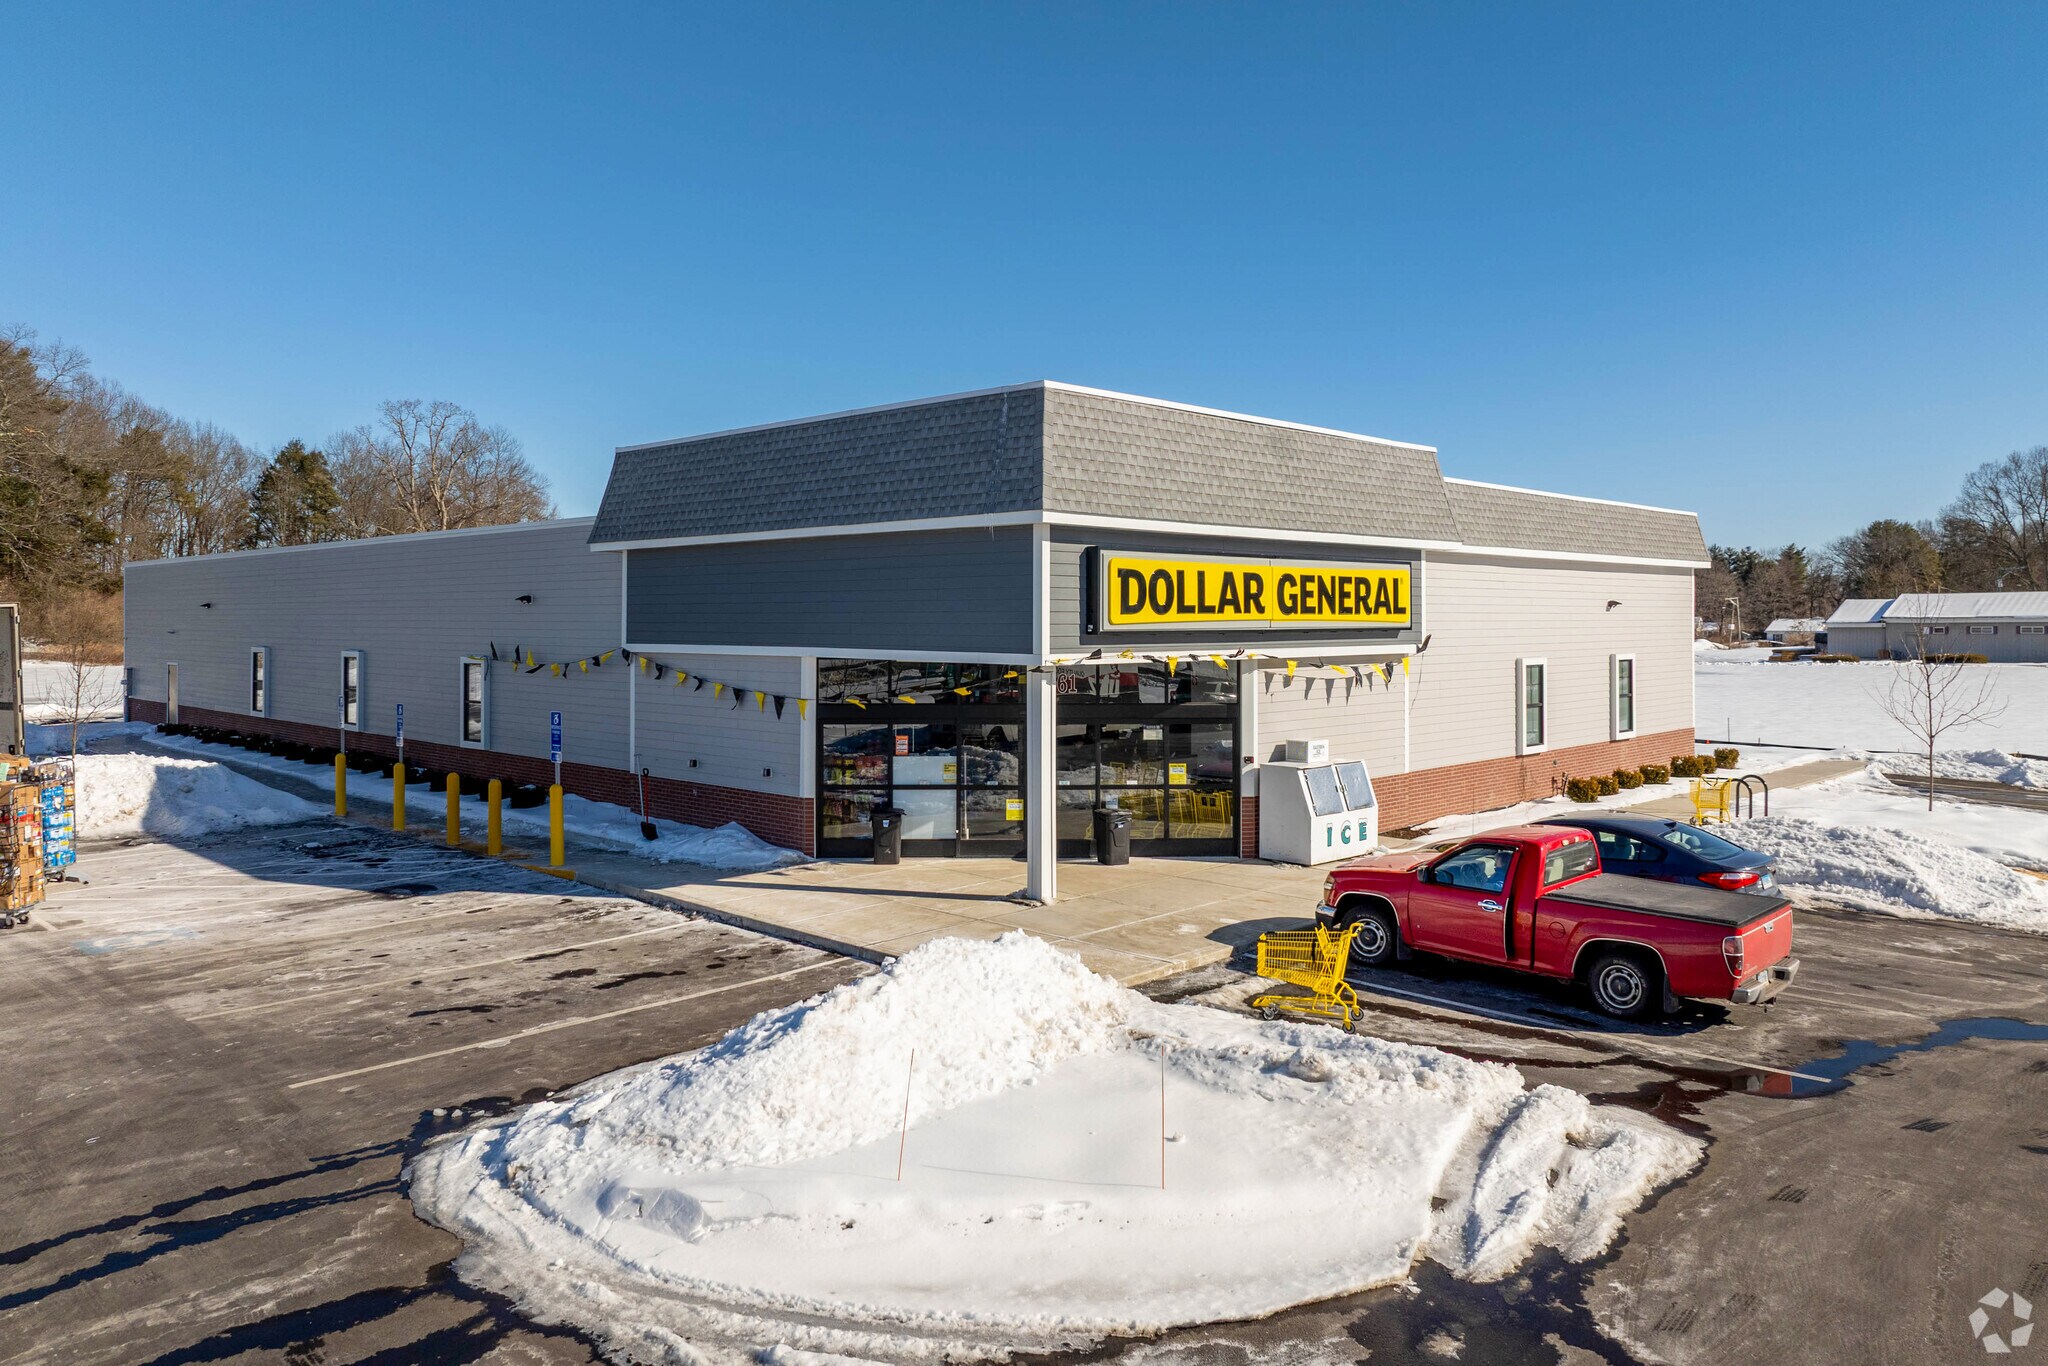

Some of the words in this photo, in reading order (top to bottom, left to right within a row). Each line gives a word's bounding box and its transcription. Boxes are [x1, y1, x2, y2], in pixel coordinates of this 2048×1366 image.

[1117, 568, 1266, 616] DOLLAR
[1276, 573, 1407, 616] GENERAL
[1057, 672, 1078, 694] 61
[1326, 817, 1368, 848] ICE
